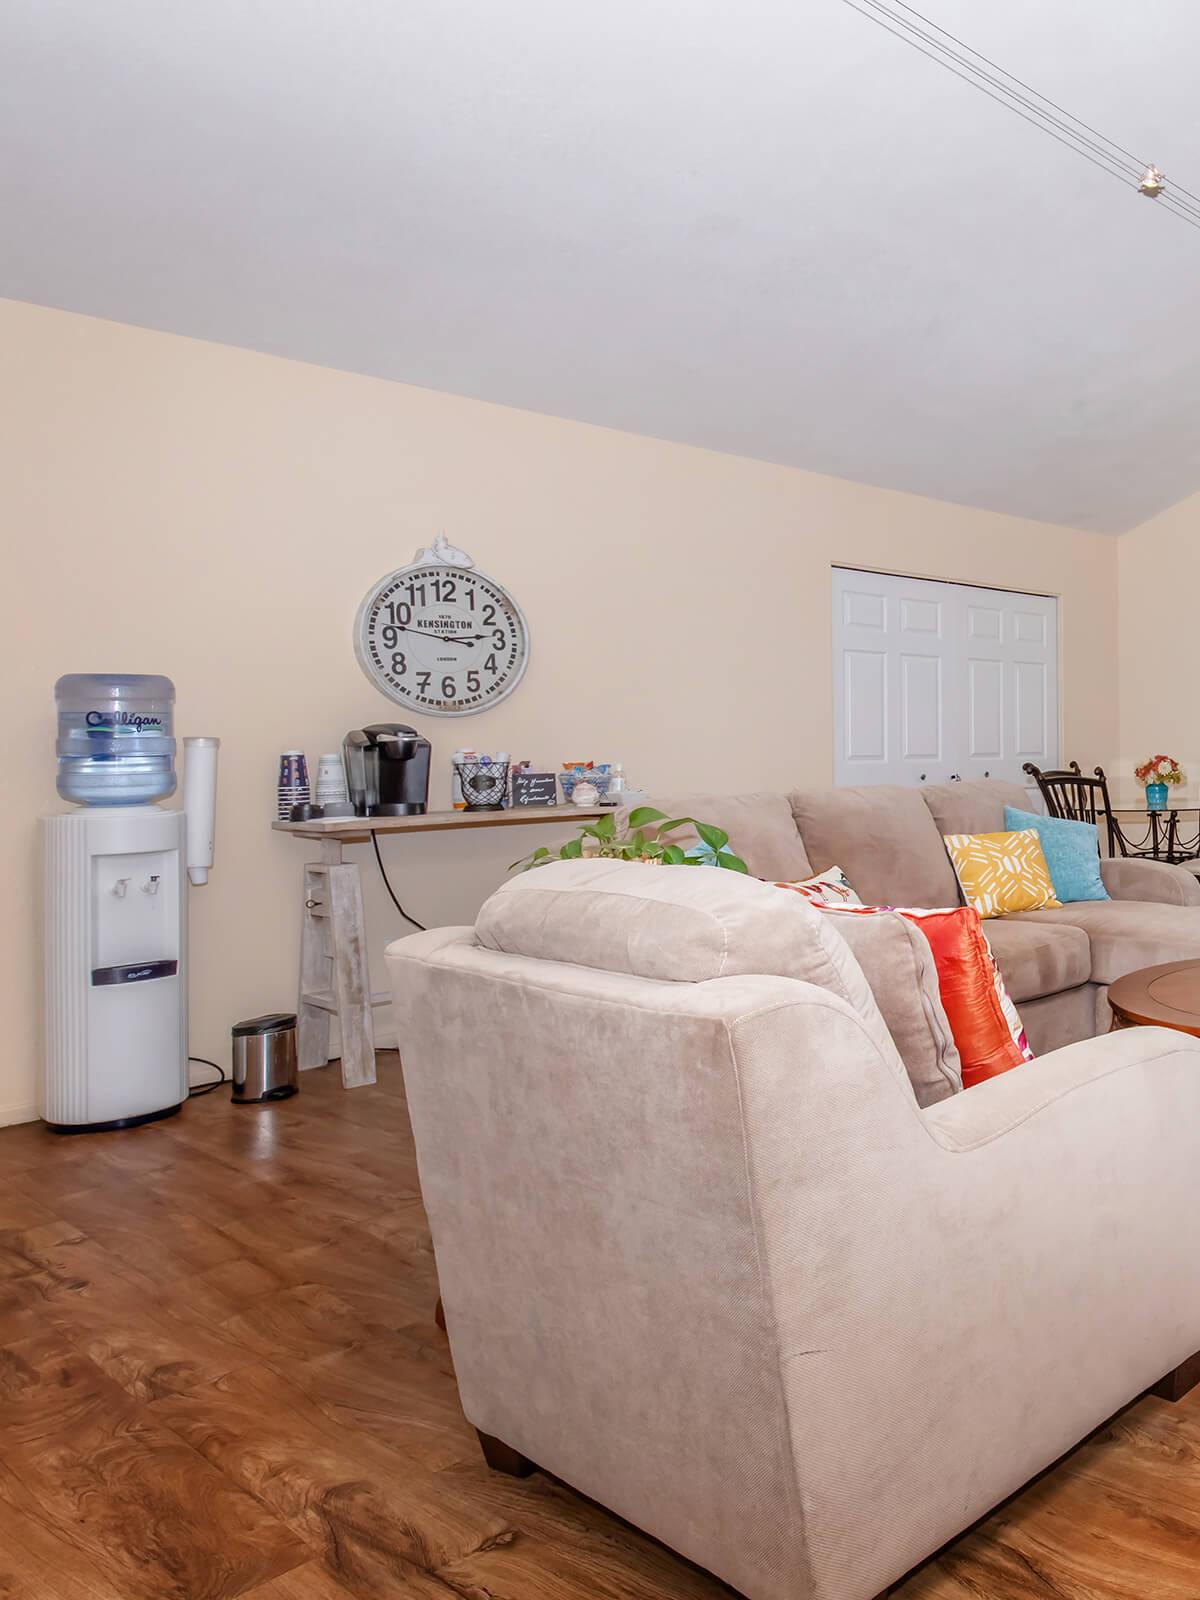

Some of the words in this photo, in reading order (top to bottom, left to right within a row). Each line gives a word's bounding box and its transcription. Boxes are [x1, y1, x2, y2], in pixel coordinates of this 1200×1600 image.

[405, 583, 427, 607] 11
[430, 579, 457, 603] 12
[465, 589, 475, 611] 1
[385, 601, 411, 625] 10
[417, 619, 472, 629] KENSINGTON
[482, 604, 496, 626] 2
[382, 625, 398, 649] 9
[492, 629, 506, 651] 3
[391, 652, 407, 675] 8
[483, 653, 498, 675] 4
[415, 671, 431, 694] 7
[441, 676, 456, 698] 6
[466, 670, 480, 693] 5
